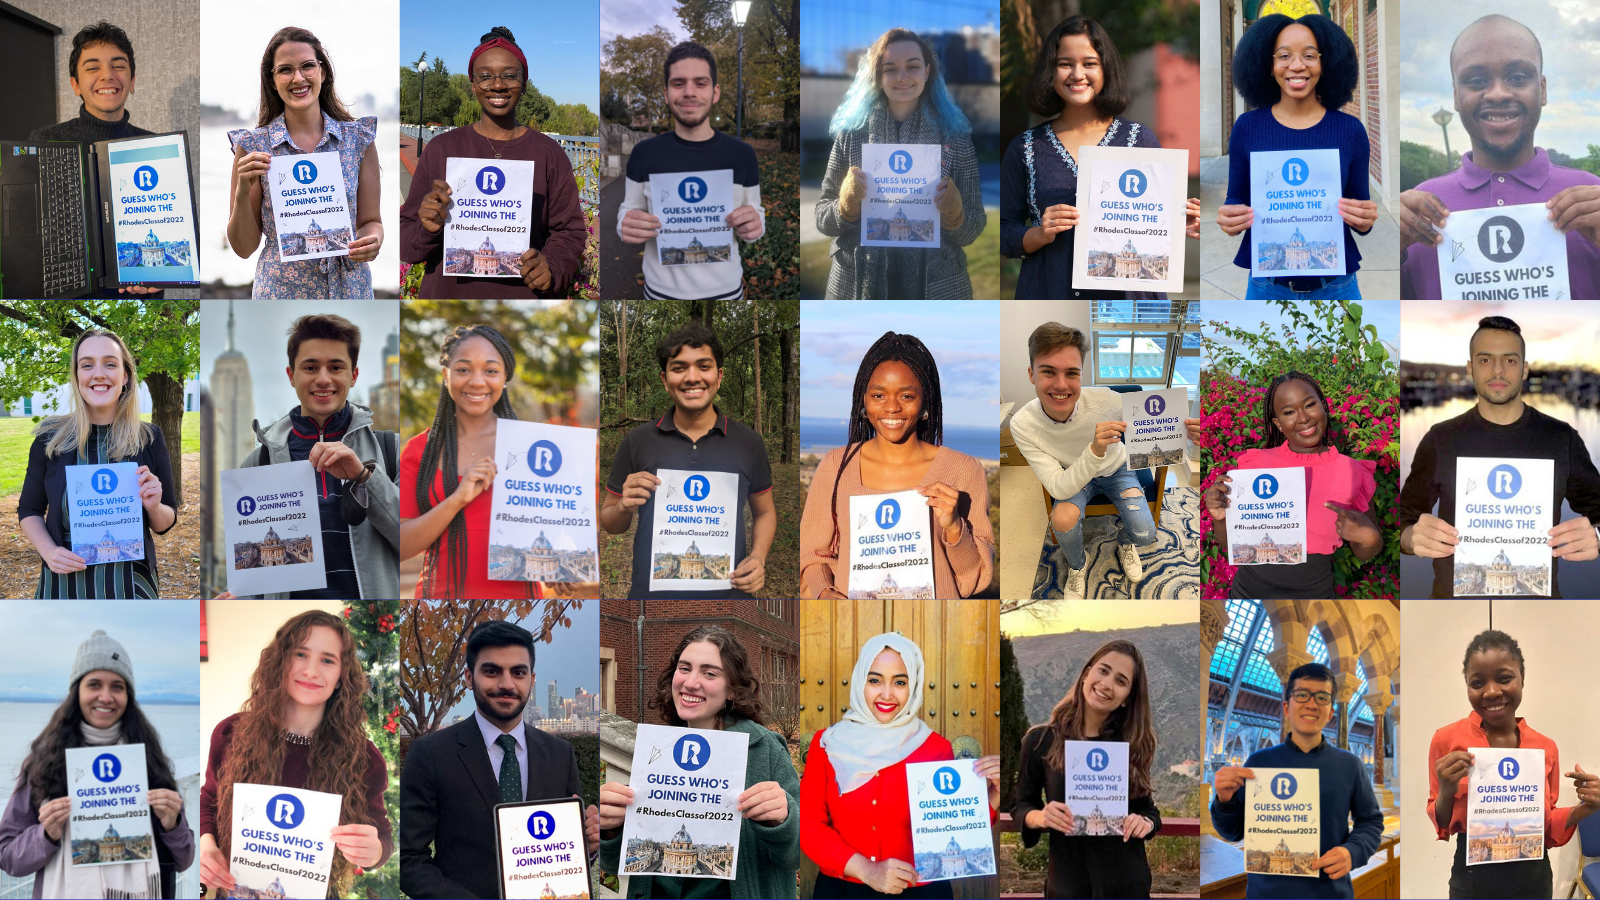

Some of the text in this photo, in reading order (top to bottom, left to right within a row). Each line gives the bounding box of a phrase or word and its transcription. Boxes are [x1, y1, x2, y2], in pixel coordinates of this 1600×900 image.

[894, 155, 906, 170] R
[139, 170, 152, 187] R
[298, 165, 312, 180] R
[1289, 163, 1302, 181] R
[483, 172, 497, 190] R
[1125, 174, 1140, 193] R
[281, 185, 335, 197] GUESS WHO'S
[685, 182, 700, 199] R
[1266, 189, 1326, 199] GUESS WHO'S
[121, 193, 176, 204] GUESS WHO'S
[285, 195, 333, 207] JOINING THE
[457, 199, 521, 208] GUESS WHO'S
[124, 205, 156, 214] JOINING
[280, 206, 344, 218] #RhodesClassof2022
[694, 205, 725, 213] WHO'S
[1101, 201, 1163, 211] GUESS WHO'S
[1268, 201, 1321, 211] JOINING THE
[118, 216, 184, 226] #RhodesClassof2022
[459, 210, 516, 220] JOINING THE
[666, 216, 702, 224] JOINING
[1102, 213, 1158, 223] JOINING THE
[1261, 215, 1333, 224] #RhodesClassof2022
[450, 224, 526, 233] #RhodesClassof2022
[660, 224, 731, 234] #RhodesClassof2022
[1094, 226, 1167, 236] #RhodesClassof2022
[1489, 225, 1513, 254] R
[1455, 266, 1554, 285] GUESS WHO'S
[1462, 285, 1549, 300] JOINING THE
[1149, 399, 1160, 413] R
[535, 447, 553, 471] R
[98, 474, 111, 490] R
[505, 479, 582, 496] GUESS WHO'S
[690, 479, 703, 497] R
[1259, 479, 1272, 495] R
[1495, 471, 1512, 493] R
[77, 496, 134, 507] GUESS WHO'S
[257, 491, 303, 502] GUESS WHO'S
[506, 495, 576, 510] JOINING THE
[241, 500, 251, 513] R
[259, 502, 287, 510] JOINING
[666, 504, 724, 514] GUESS WHO'S
[1266, 501, 1294, 509] WHO'S
[1466, 504, 1541, 515] GUESS WHO'S
[80, 508, 114, 517] JOINING
[881, 505, 894, 524] R
[1276, 511, 1289, 519] THE
[74, 517, 140, 528] #RhodesClassof2022
[239, 513, 306, 526] #RhodesClassof2022
[496, 513, 590, 526] #RhodesClassof2022
[668, 516, 720, 525] JOINING THE
[1467, 519, 1535, 529] JOINING THE
[659, 529, 729, 537] #RhodesClassof2022
[859, 531, 921, 544] GUESS WHO'S
[860, 544, 916, 557] JOINING THE
[853, 558, 929, 570] #RhodesClassof2022
[681, 740, 701, 765] R
[1091, 752, 1103, 768] R
[99, 759, 114, 778] R
[1503, 761, 1514, 776] R
[647, 774, 728, 789] GUESS WHO'S
[939, 772, 954, 790] R
[1277, 777, 1291, 795] R
[77, 784, 140, 797] GUESS WHO'S
[648, 790, 721, 804] JOINING THE
[80, 797, 136, 809] JOINING THE
[919, 797, 979, 809] GUESS WHO'S
[1480, 795, 1516, 803] JOINING
[73, 810, 148, 822] #RhodesClassof2022
[274, 799, 295, 824] R
[636, 807, 733, 821] #RhodesClassof2022
[923, 809, 975, 820] JOINING THE
[533, 816, 549, 835] R
[916, 822, 986, 834] #RhodesClassof2022
[242, 829, 323, 851] GUESS WHO'S
[243, 842, 315, 864] JOINING THE
[512, 841, 574, 855] GUESS WHO'S
[516, 854, 571, 867] JOINING THE
[233, 856, 326, 882] #RhodesClassof2022
[509, 867, 582, 881] #RhodesClassof2022
